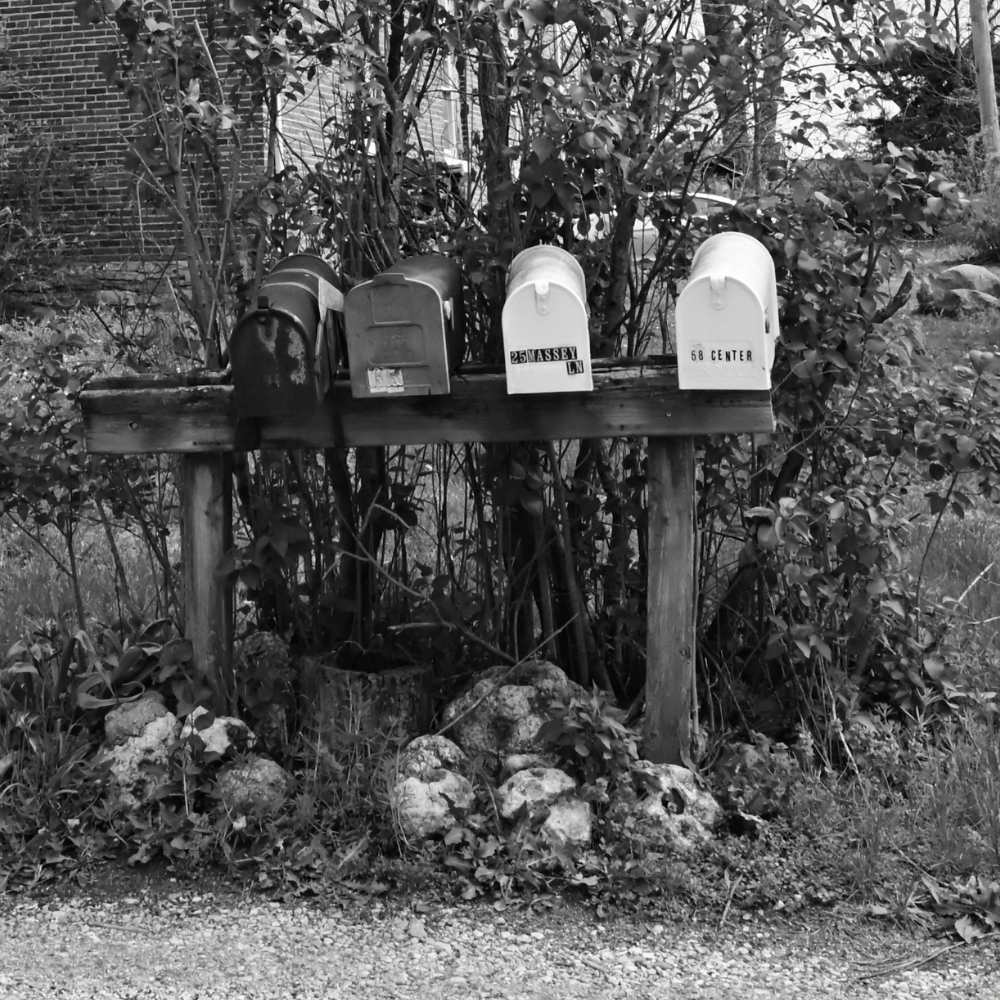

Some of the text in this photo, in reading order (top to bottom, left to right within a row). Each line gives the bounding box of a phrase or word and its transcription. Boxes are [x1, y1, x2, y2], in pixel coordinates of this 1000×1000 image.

[511, 347, 577, 364] 25 MASSEY
[691, 349, 753, 362] 68 CENTER
[567, 361, 584, 374] LN
